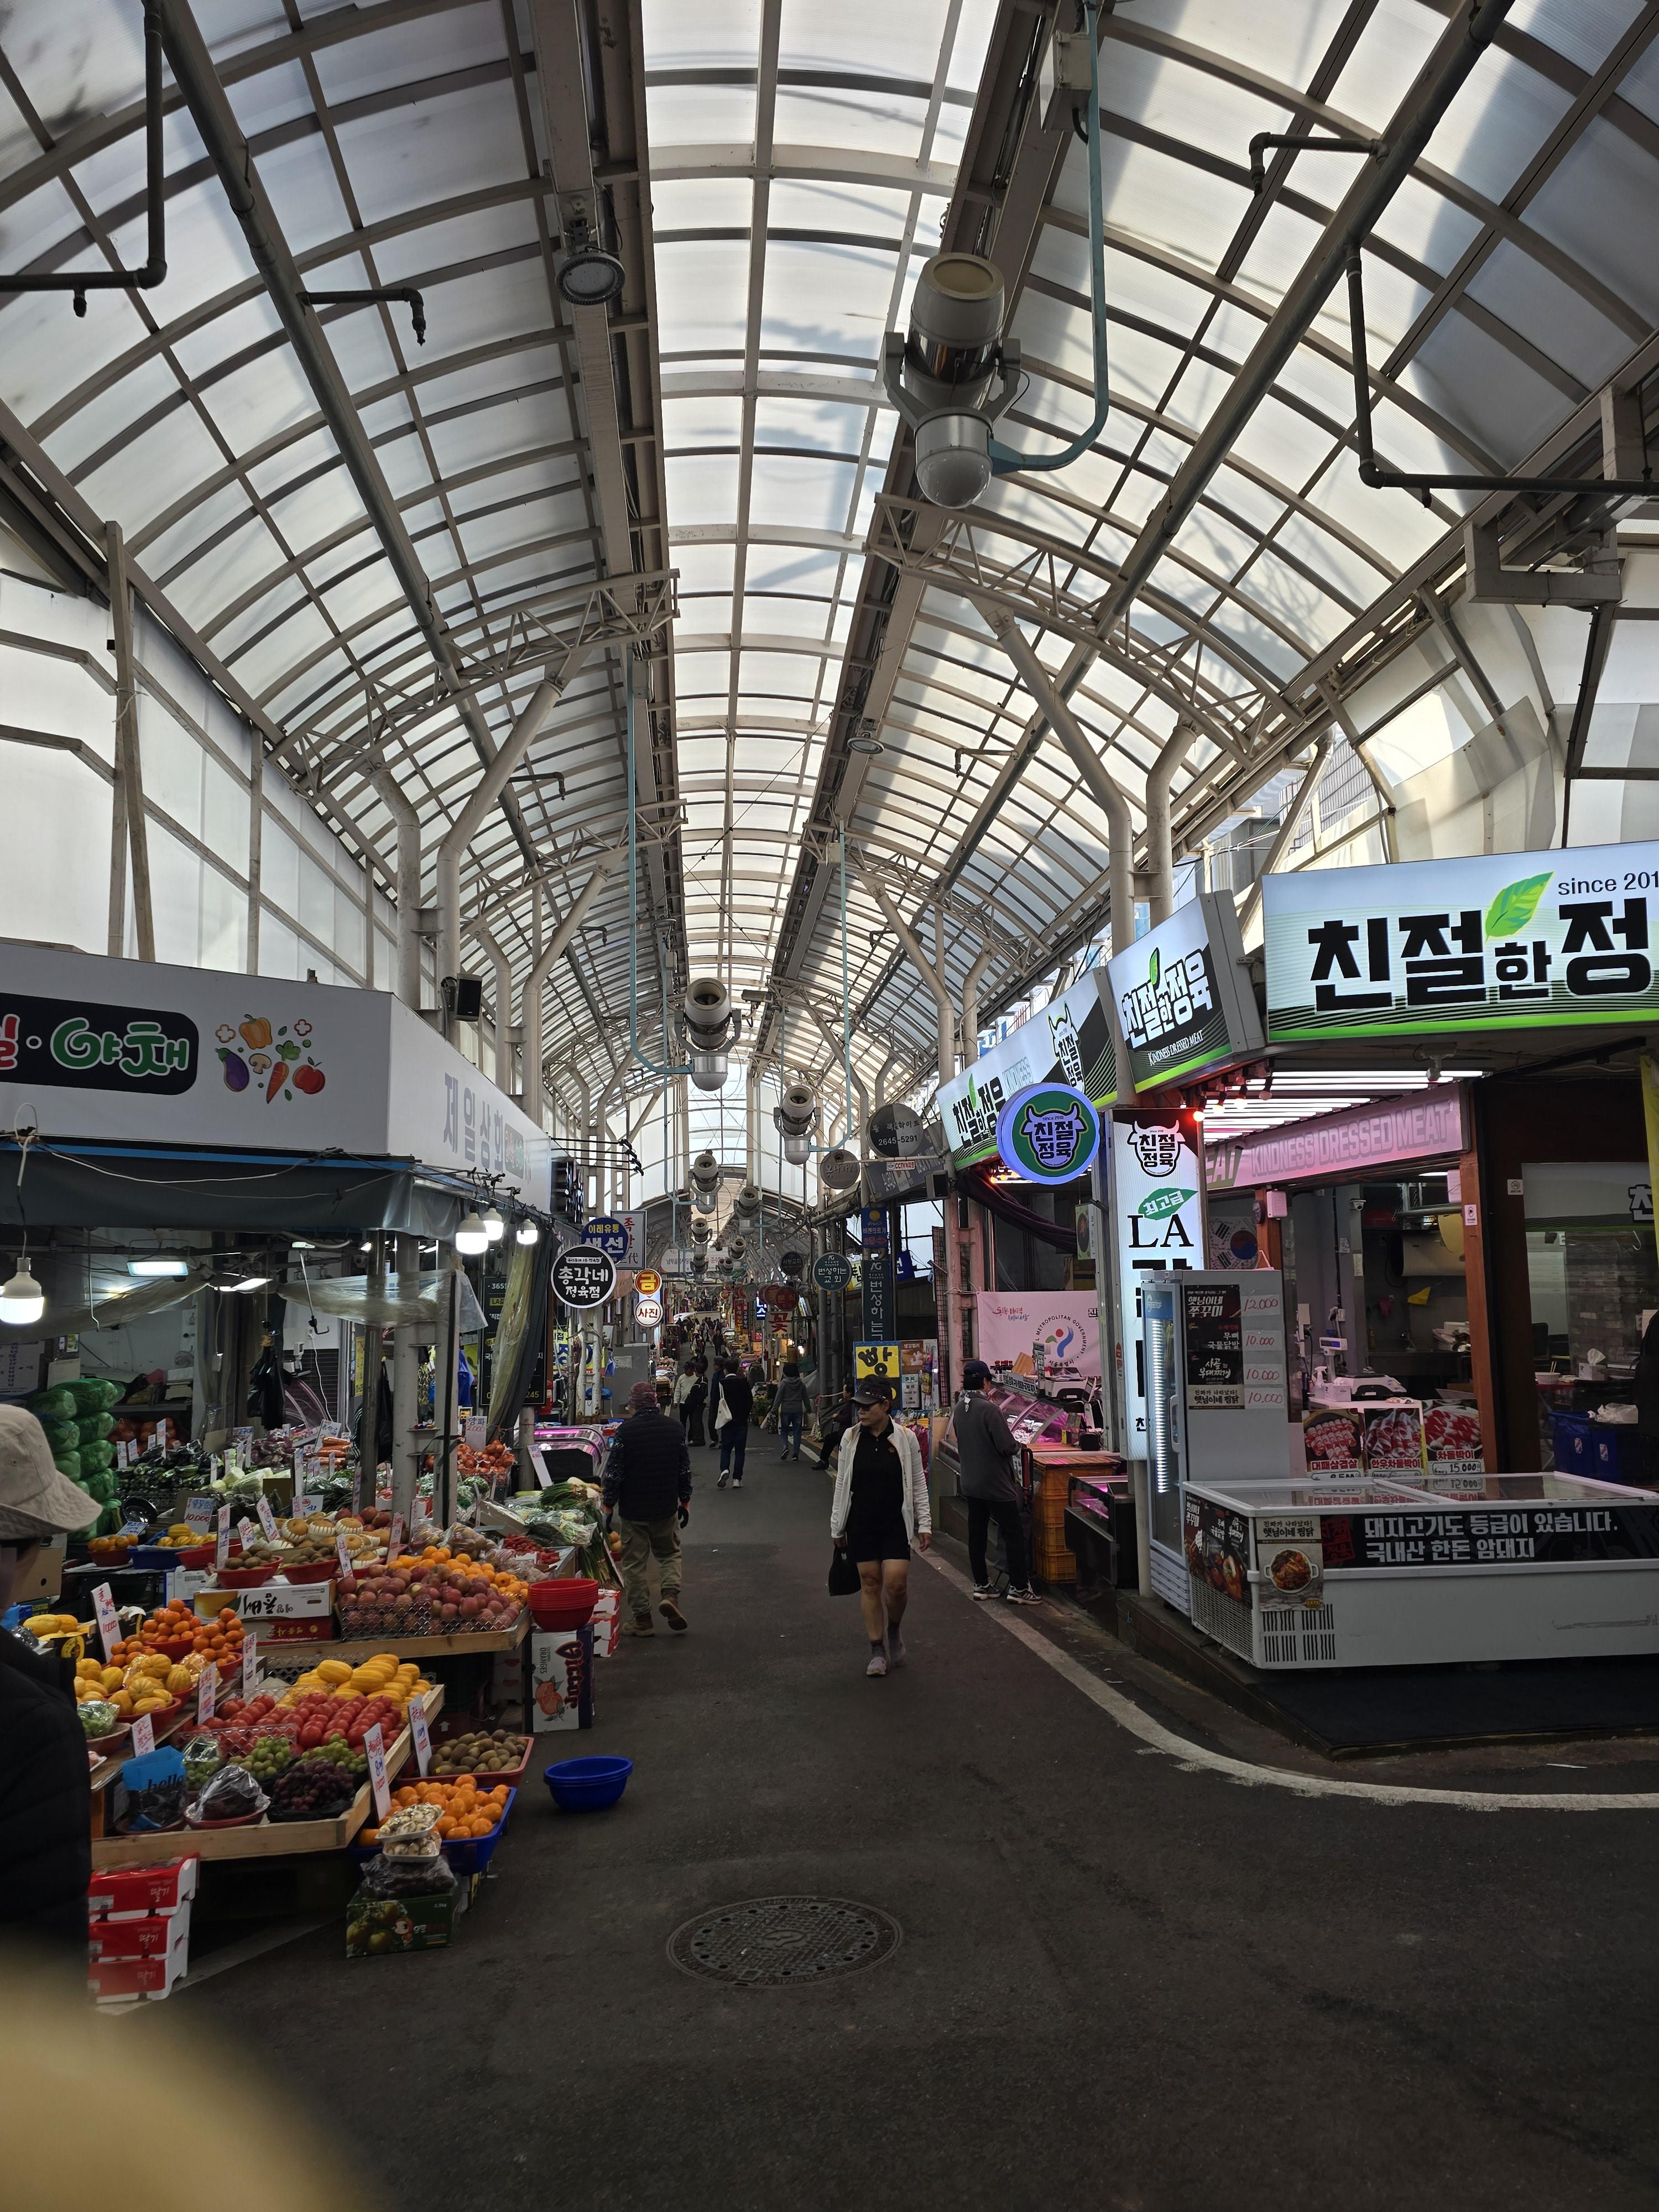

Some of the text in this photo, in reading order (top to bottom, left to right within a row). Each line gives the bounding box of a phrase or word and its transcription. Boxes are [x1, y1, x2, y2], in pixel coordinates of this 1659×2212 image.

[1558, 875, 1618, 895] since
[1122, 951, 1213, 1049] 친절한정육
[50, 1016, 189, 1078] 야채
[1058, 1034, 1078, 1066] 친절
[1148, 1030, 1204, 1066] KINDNESS DRESSED MEAT
[1067, 1061, 1084, 1088] 정육
[443, 1072, 504, 1173] 제일상회
[1034, 1120, 1074, 1142] 친절
[878, 1134, 918, 1146] 2645-5291
[1139, 1134, 1176, 1152] 친절
[1250, 1099, 1452, 1177] KINDNESS DRESSED MEAT
[1038, 1141, 1072, 1160] 정육
[1142, 1152, 1173, 1168] 정육
[1207, 1145, 1243, 1183] EAT
[1142, 1190, 1185, 1216] 최고급
[588, 1224, 620, 1234] 이레유통
[1127, 1213, 1194, 1248] LA
[557, 1266, 609, 1285] 총각네
[818, 1267, 847, 1276] 번성하는
[639, 1273, 656, 1291] 금
[565, 1285, 601, 1299] 정육점
[1187, 1296, 1224, 1305] 햇님이네
[637, 1307, 658, 1319] 사진
[1188, 1306, 1223, 1318] 쭈꾸미
[768, 1312, 793, 1333] 꽃
[1037, 1314, 1088, 1355] METROPOLITAN GOVERNMENT
[1207, 1340, 1240, 1350] 국물닭발
[1204, 1358, 1222, 1370] 사골
[1198, 1368, 1232, 1379] 부대찌개
[1194, 1395, 1239, 1405] 햇님이네 찜닭
[1371, 1458, 1420, 1470] 한우차돌박이
[1437, 1450, 1474, 1461] 차돌박이
[1311, 1459, 1358, 1471] 대패삼겹살
[1262, 1526, 1315, 1538] 햇님이네 찜닭
[1364, 1511, 1619, 1539] 돼지고기도 등급이 있습니다.
[1365, 1537, 1535, 1563] 국내산 한돈 암돼지
[149, 1886, 170, 1903] 딸기
[138, 1933, 159, 1950] 딸기
